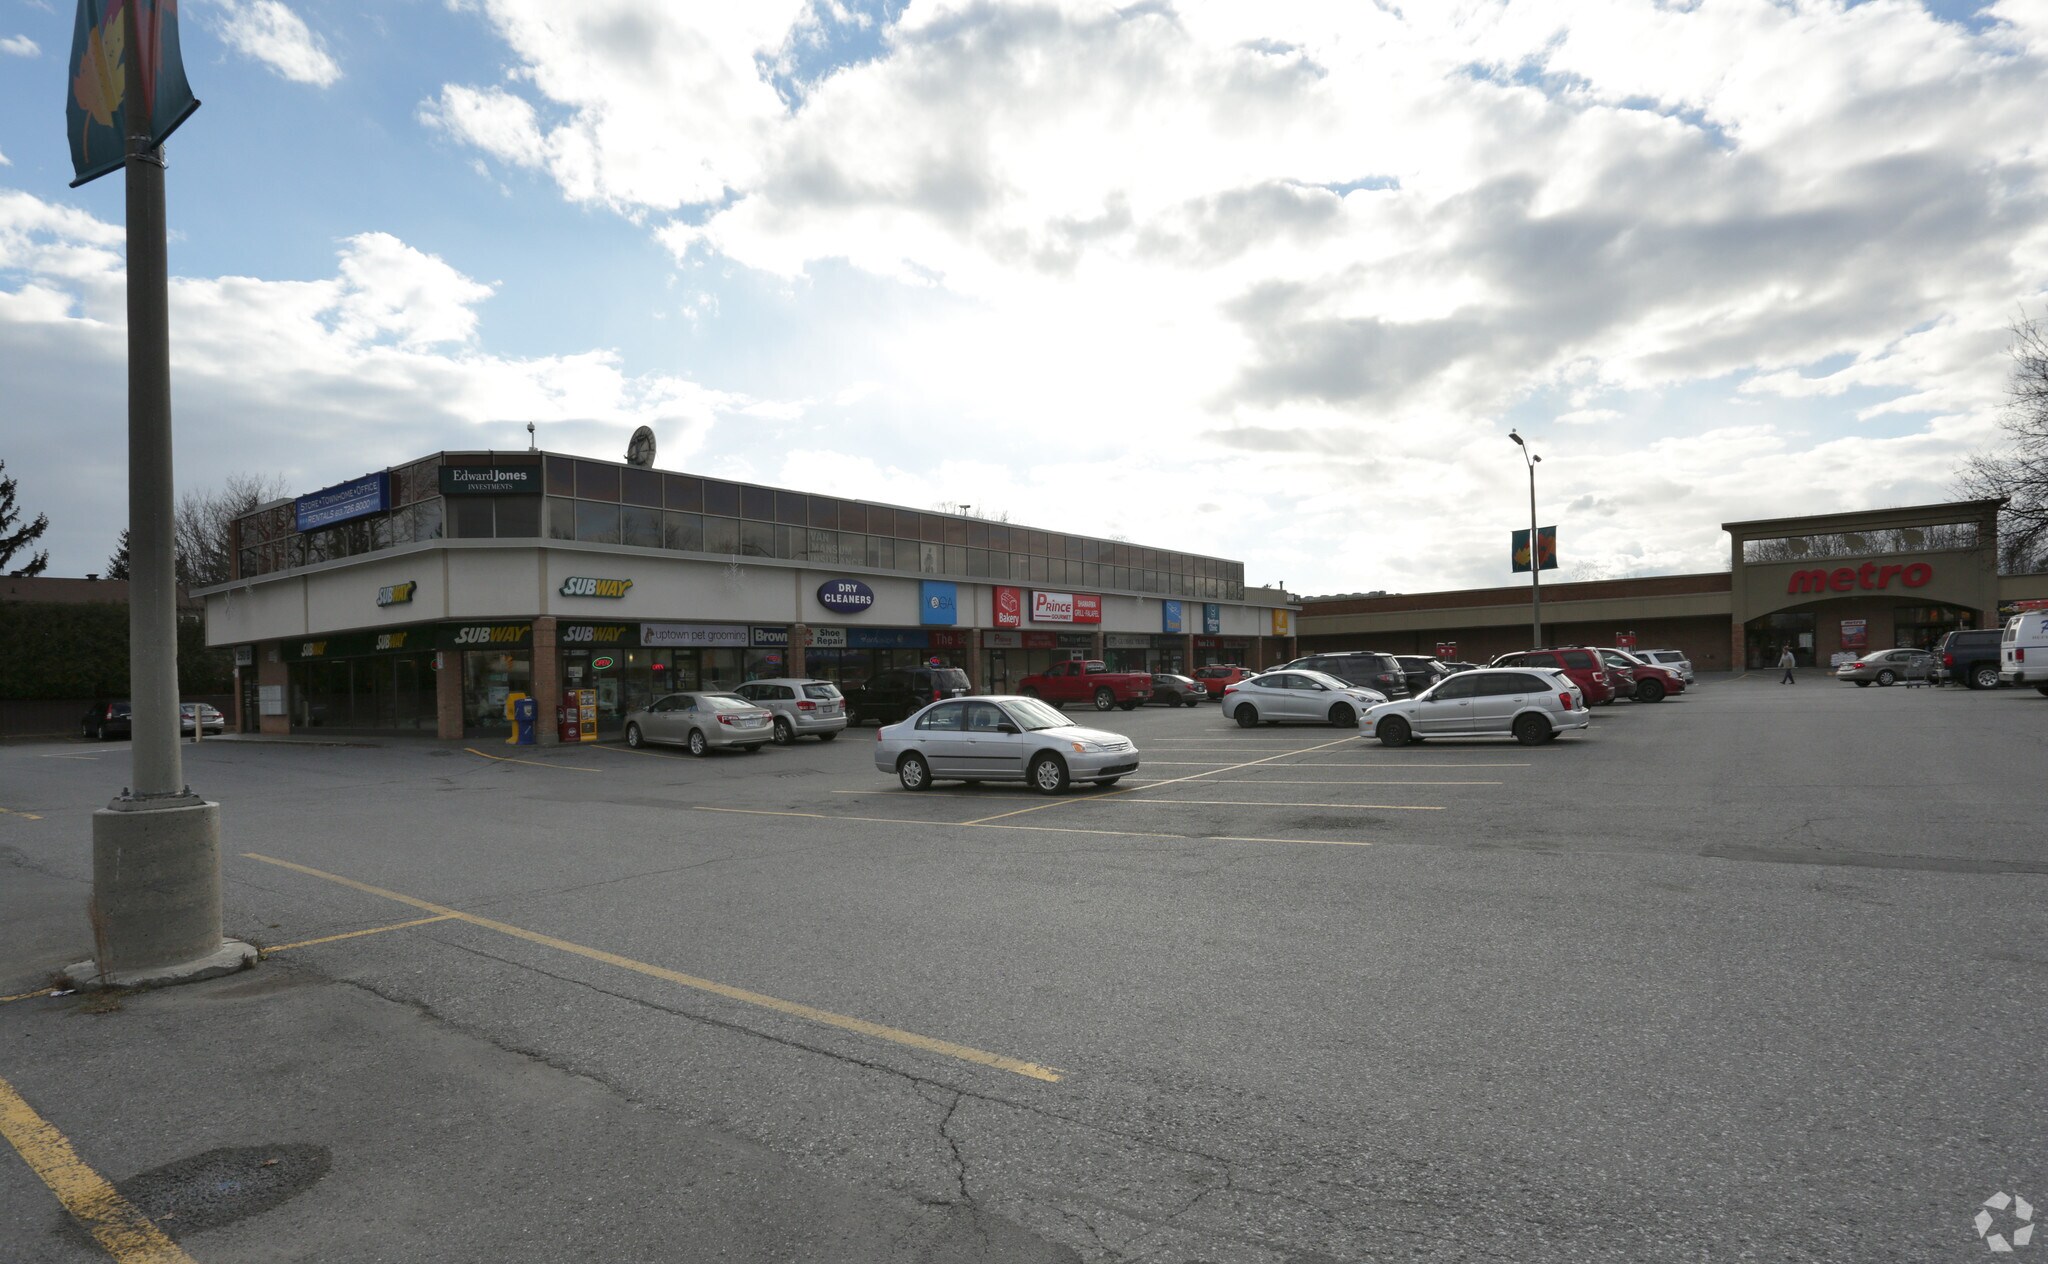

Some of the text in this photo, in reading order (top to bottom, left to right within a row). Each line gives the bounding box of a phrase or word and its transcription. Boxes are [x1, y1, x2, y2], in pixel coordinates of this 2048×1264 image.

[1788, 561, 1932, 594] metro
[377, 582, 414, 605] SUBWAY
[563, 577, 633, 597] SUBWAY
[838, 583, 858, 593] DRY
[824, 593, 872, 605] CLEANERS
[998, 612, 1020, 626] Bakery
[454, 625, 531, 644] SUBWAY
[563, 626, 626, 642] SUBWAY
[655, 630, 747, 643] uptown pet grooming
[819, 628, 840, 638] Shoe
[935, 633, 953, 646] The
[376, 632, 408, 650] SUBWAY
[816, 636, 844, 647] Repair
[594, 658, 611, 667] OPEN
